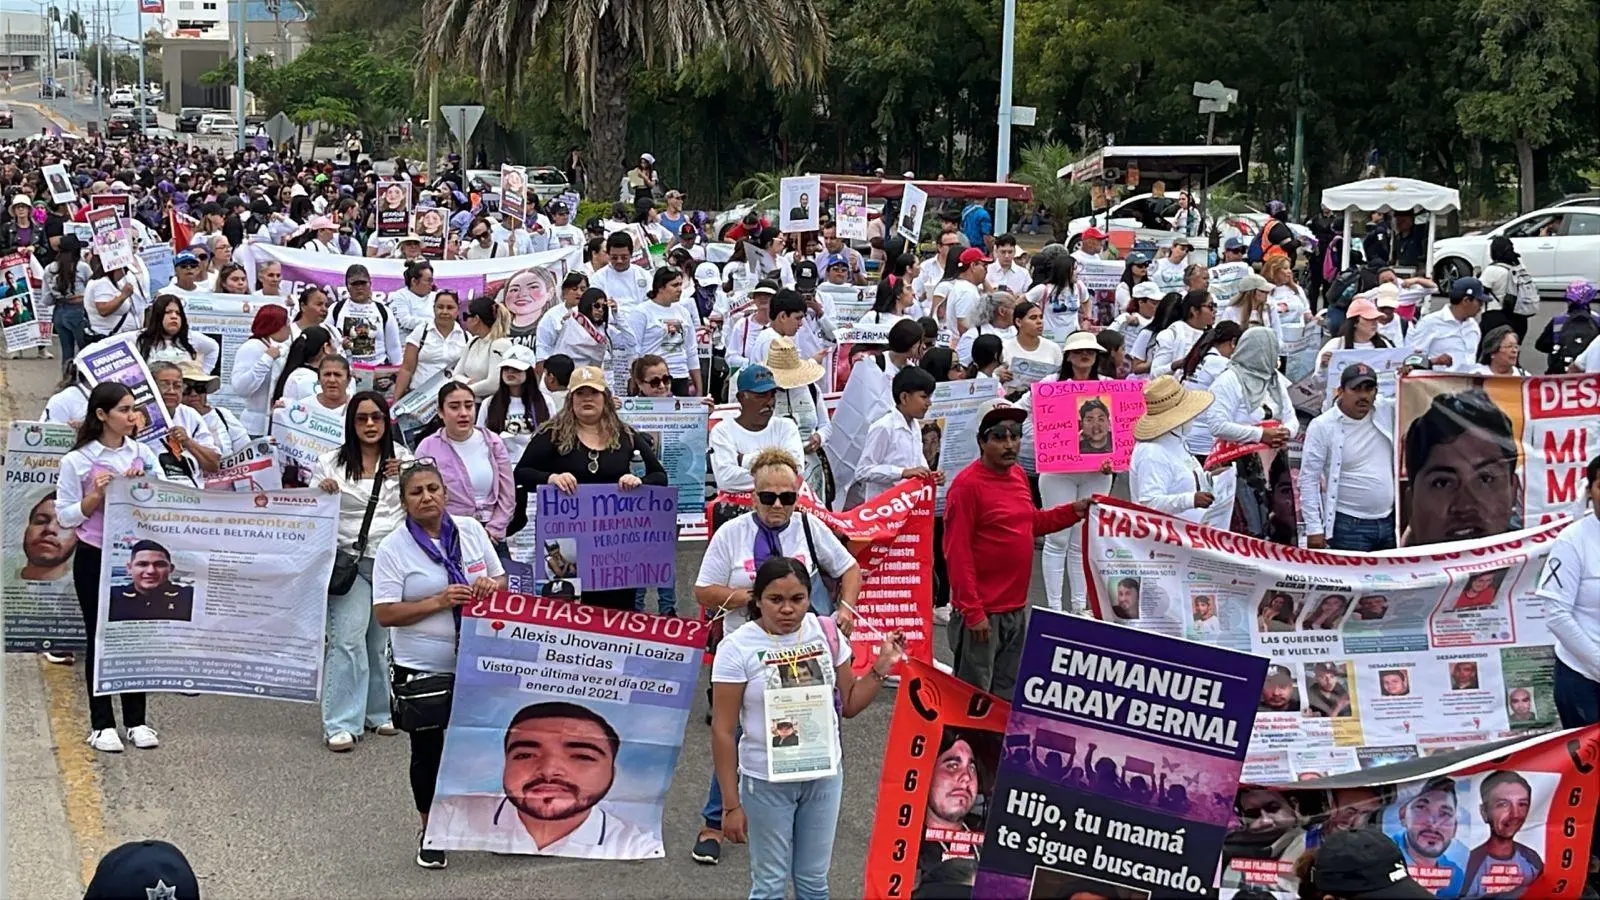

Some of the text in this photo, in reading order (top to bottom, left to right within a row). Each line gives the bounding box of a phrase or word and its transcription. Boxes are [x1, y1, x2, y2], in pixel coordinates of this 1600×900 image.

[839, 331, 862, 341] JORGE
[1038, 382, 1144, 398] OSCAR AGUILAR
[1541, 378, 1600, 411] DES
[1119, 401, 1145, 412] HASTA
[308, 419, 342, 438] Sinaloa
[276, 442, 304, 458] CARLOS
[1544, 428, 1587, 464] MI
[6, 470, 46, 483] PABLO
[156, 491, 318, 505] Sinaloa SINALOA
[542, 489, 579, 520] Hoy
[228, 514, 303, 528] encontrar
[593, 516, 652, 533] HERMANA
[1098, 507, 1183, 548] HASTA
[137, 521, 306, 542] MIGUEL ÁNGEL BELTRÁN LEÓN
[594, 533, 620, 548] PERO
[643, 530, 674, 543] FALTA
[1119, 568, 1138, 576] NOEL
[1285, 574, 1307, 583] NOS
[471, 592, 701, 641] ¿LO HAS VISTO?
[895, 617, 924, 628] tiempos
[510, 626, 685, 663] Alexis Jhovanni Loaiza
[1261, 634, 1339, 645] LAS QUEREMOS
[545, 649, 614, 670] Bastidas
[1287, 647, 1330, 656] VUELTA!
[1436, 652, 1488, 661] DESAPARECIDO
[482, 660, 674, 694] Visto por última vez el día 02 de
[1051, 645, 1226, 710] EMMANUEL
[526, 681, 624, 702] enero del 2021.
[1023, 676, 1241, 749] GARAY BERNAL
[1006, 787, 1187, 856] Hijo, tu mamá
[997, 824, 1208, 896] te sigue buscando.
